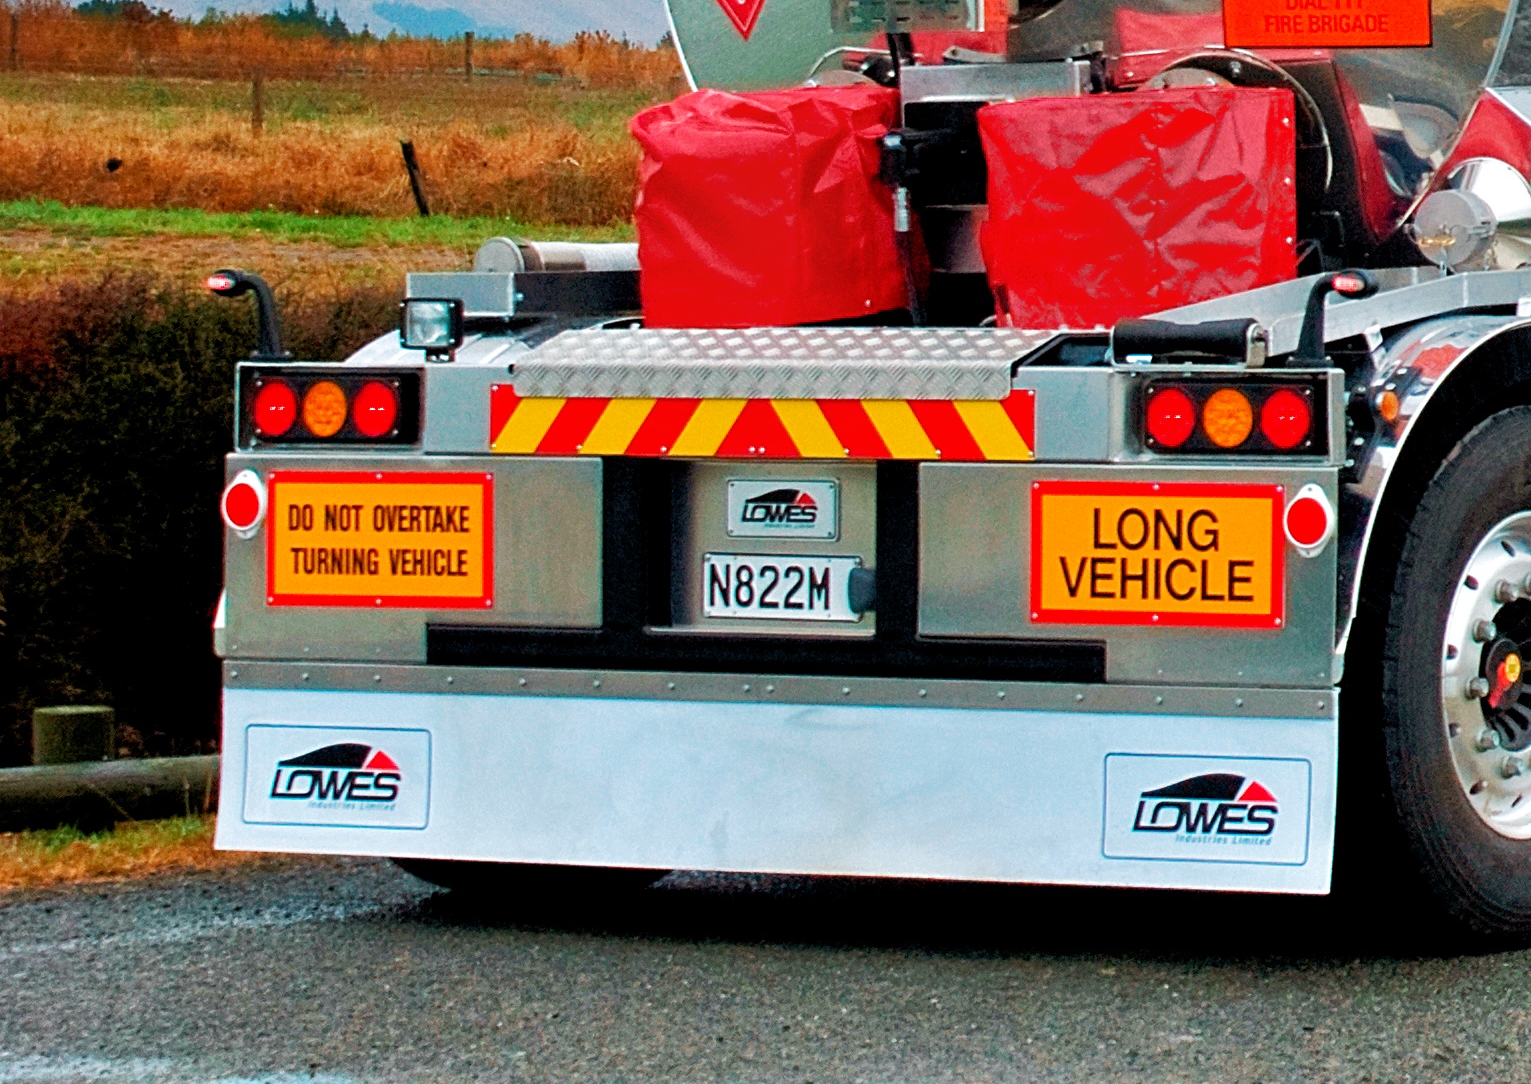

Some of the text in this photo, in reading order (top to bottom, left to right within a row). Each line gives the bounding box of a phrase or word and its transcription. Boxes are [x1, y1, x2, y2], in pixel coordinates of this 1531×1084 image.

[1264, 14, 1389, 33] FIRE BRIGADE
[288, 504, 470, 533] DO NOT OVERTAKE
[741, 504, 818, 523] LOWES
[1093, 507, 1219, 551] LONG
[291, 547, 468, 576] TURNING VEHICLE
[709, 563, 830, 610] N822M
[1059, 557, 1254, 602] VEHICLE
[270, 769, 402, 803] LOWES
[1133, 801, 1279, 836] LOWES
